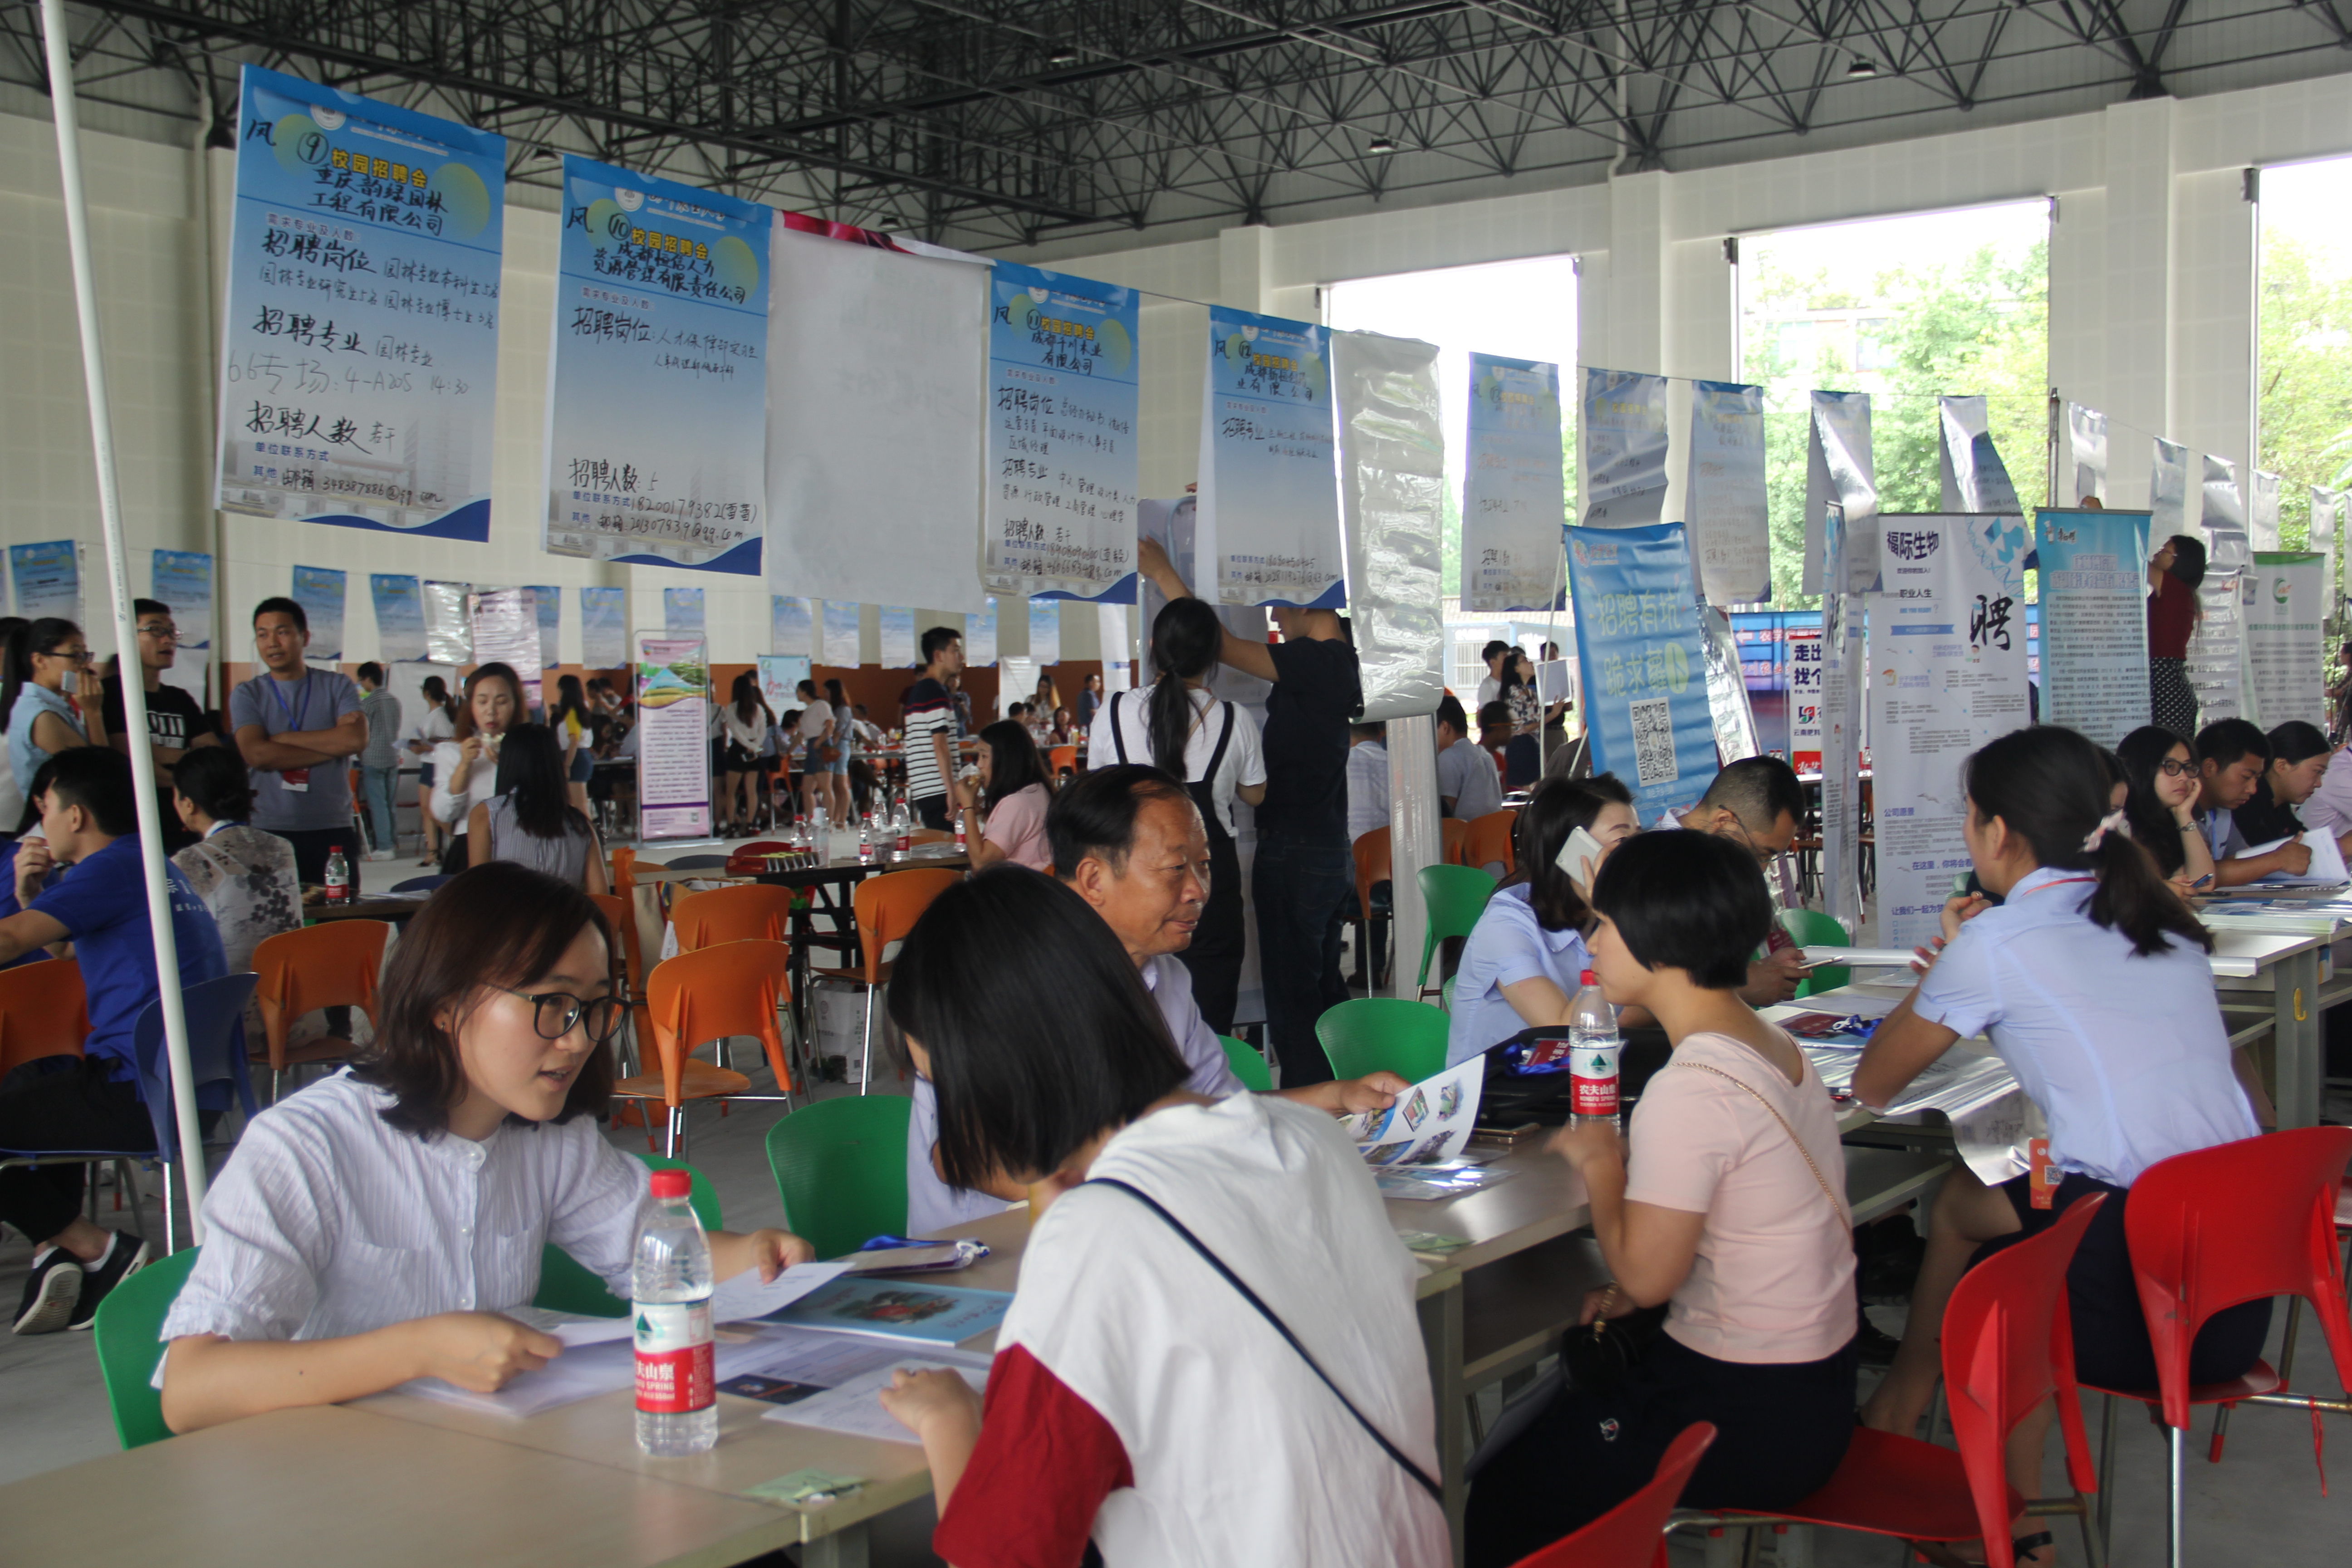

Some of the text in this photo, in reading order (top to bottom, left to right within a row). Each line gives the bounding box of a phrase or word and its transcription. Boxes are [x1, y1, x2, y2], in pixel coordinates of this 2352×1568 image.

[246, 119, 276, 147] 风
[331, 147, 427, 189] 校园招聘会
[313, 162, 448, 213] 重庆韵绿园林
[307, 191, 443, 236] 工程有限公司
[567, 206, 593, 233] 风
[261, 228, 377, 273] 招聘岗位
[631, 227, 708, 260] 校园招聘会
[593, 247, 746, 304] 资源管理有限责任公司
[994, 306, 1012, 325] 风
[253, 304, 433, 367] 招聘专业 园林专业
[1041, 316, 1094, 341] 校园招聘会
[1032, 332, 1103, 358] 成都千川木业
[1041, 349, 1093, 376] 有限公司
[1253, 353, 1298, 372] 校园招聘会
[998, 387, 1054, 415] 招聘岗位
[246, 400, 396, 455] 招聘人数 若干
[255, 442, 329, 462] 单位联系方式
[254, 466, 277, 479] 其他
[1002, 457, 1049, 479] 招聘专业
[647, 471, 658, 491] 5
[573, 490, 631, 507] 单位联系方式
[572, 512, 590, 523] 其他
[1005, 540, 1047, 552] 单位联系方式
[1886, 530, 1940, 560] 福际生物
[1004, 558, 1018, 566] 其他
[1230, 555, 1265, 564] 单位联系方式
[1899, 588, 1932, 598] 职业人生
[1595, 589, 1682, 636] 招聘有坑
[1969, 592, 2014, 651] 聘
[1884, 807, 1915, 817] 公司愿景
[1579, 1084, 1616, 1095] 农夫山泉
[646, 1381, 675, 1392] SPRING
